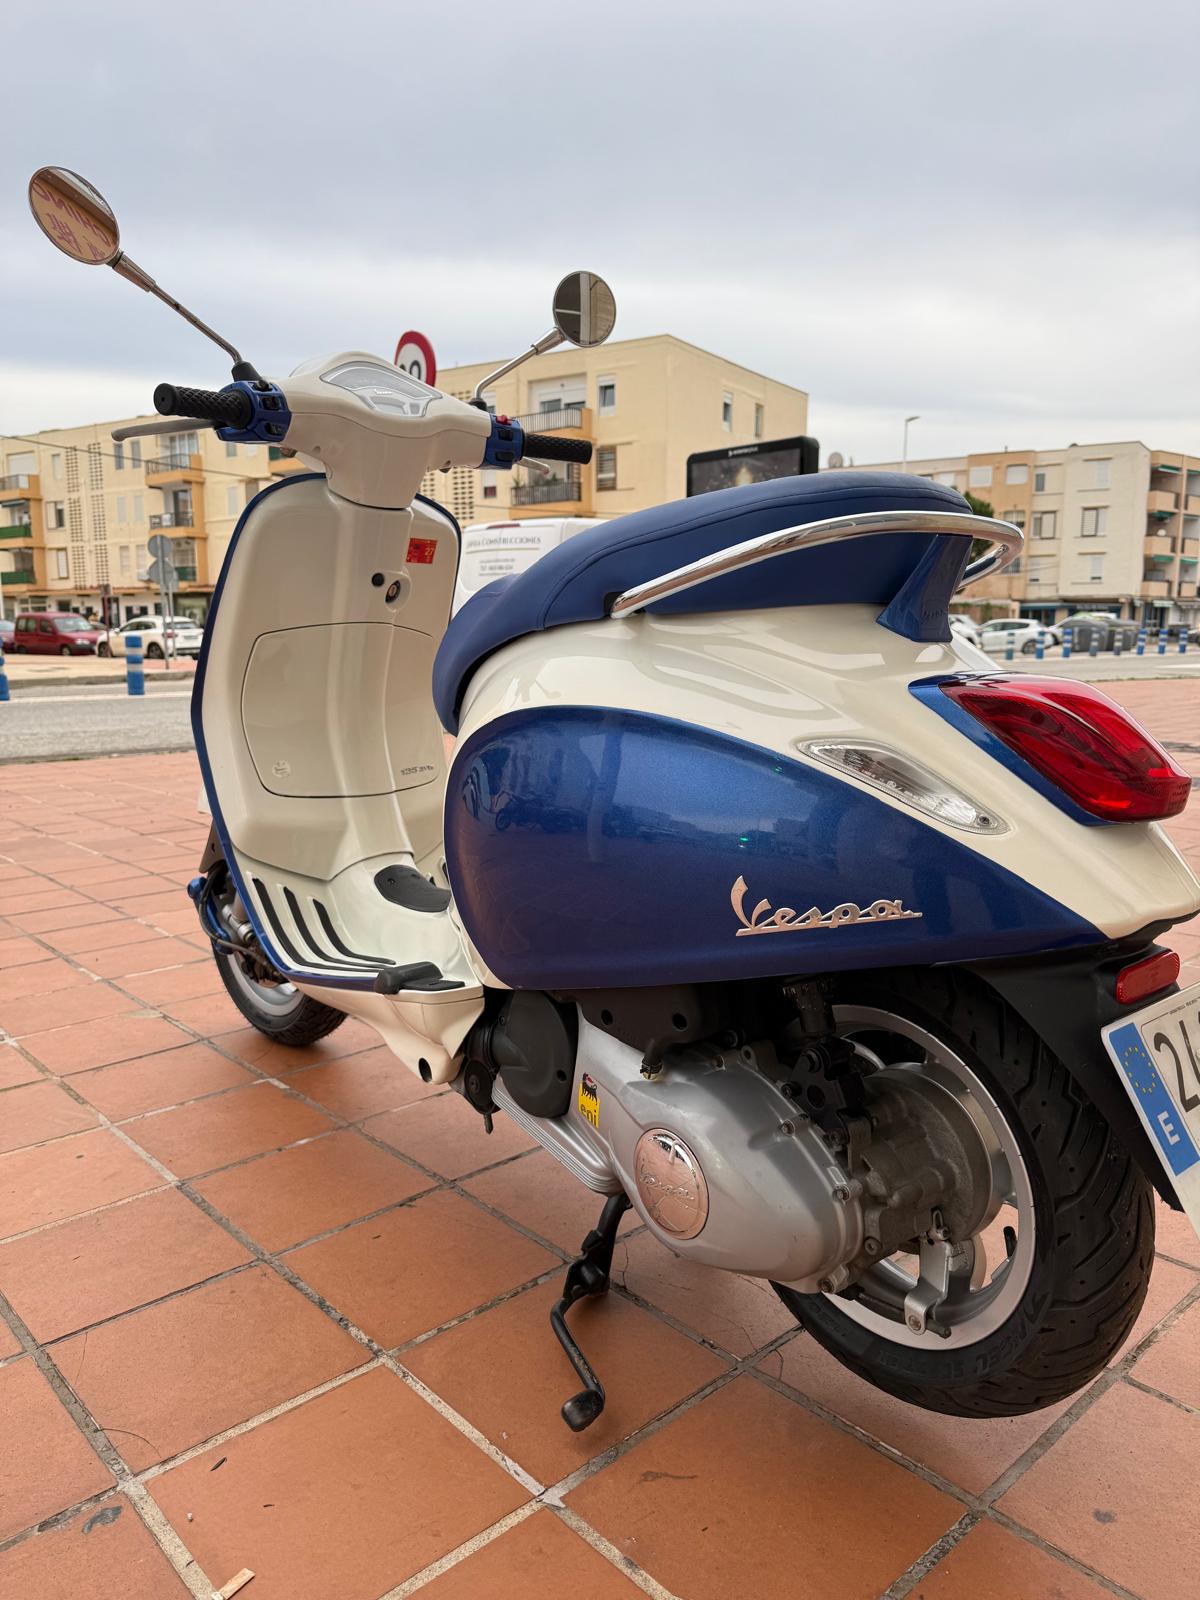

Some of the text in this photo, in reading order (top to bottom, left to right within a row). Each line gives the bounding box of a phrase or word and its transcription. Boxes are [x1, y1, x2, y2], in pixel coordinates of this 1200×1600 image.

[481, 537, 541, 545] CONSTRUCCIONES
[731, 875, 923, 936] Vespa
[580, 1103, 597, 1126] eni
[1157, 1110, 1180, 1145] E
